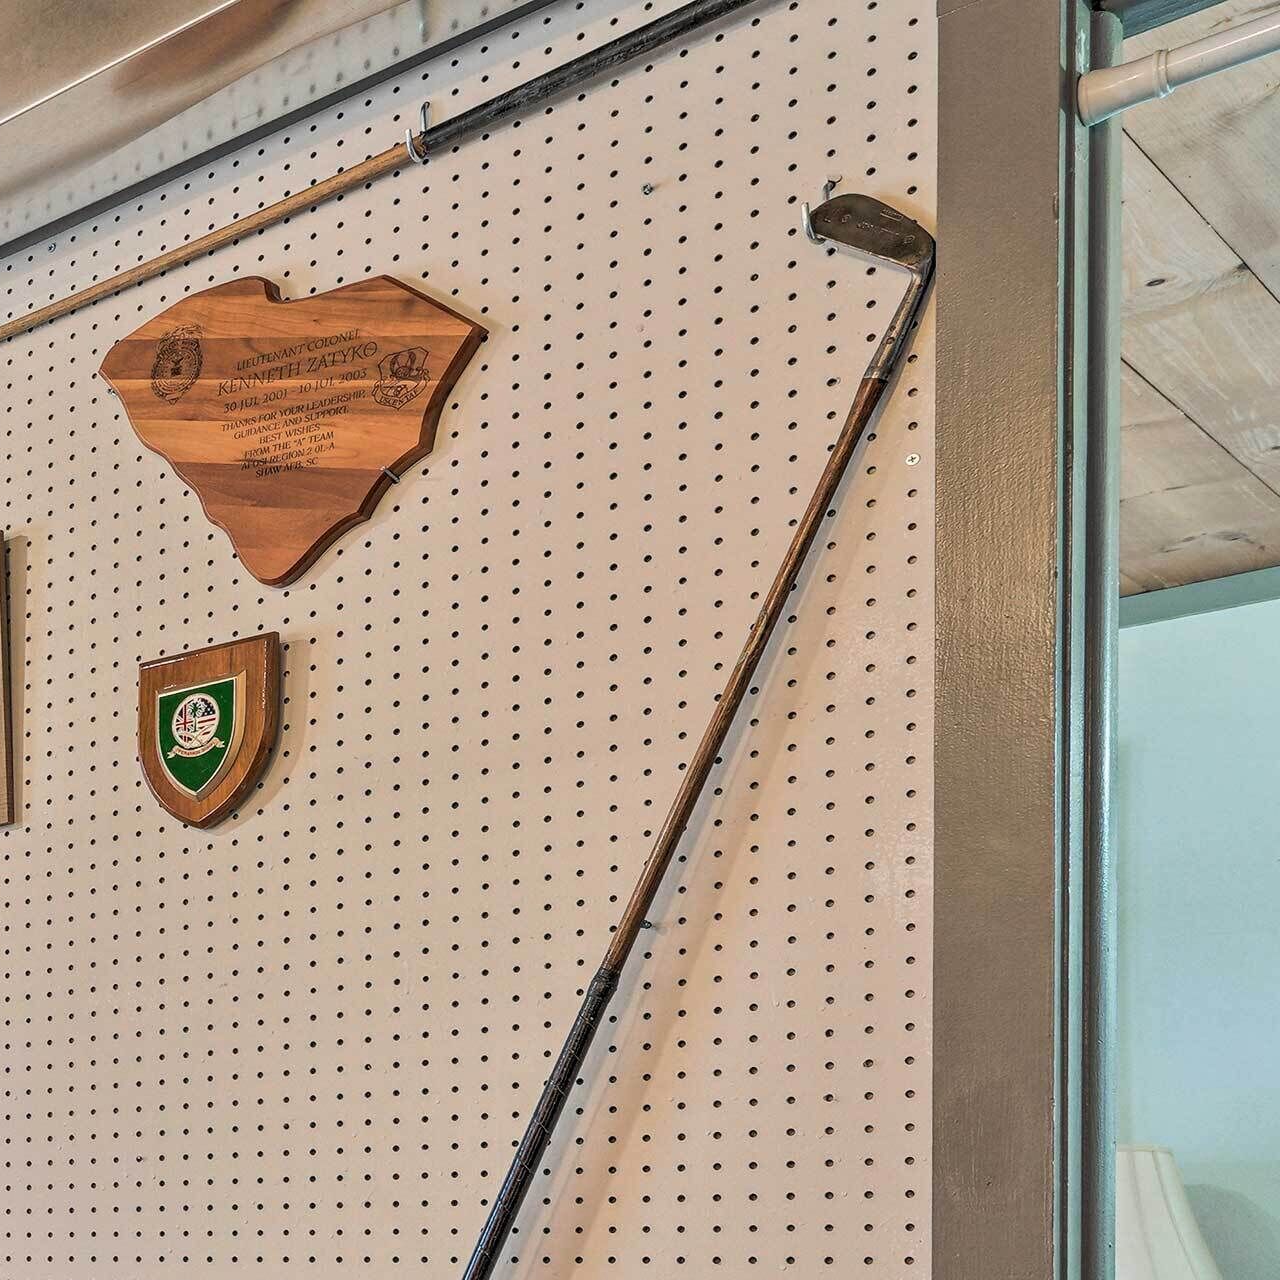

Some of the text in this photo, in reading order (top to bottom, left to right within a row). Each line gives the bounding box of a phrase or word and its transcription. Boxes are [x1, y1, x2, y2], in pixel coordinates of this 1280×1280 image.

[236, 328, 361, 371] LIEUTENANT COLONEL
[217, 341, 378, 396] KENNETH ZATYKO
[262, 390, 288, 404] 2001
[299, 382, 312, 394] 10
[338, 368, 368, 385] 2003
[221, 417, 257, 432] THANKS
[258, 412, 277, 424] FOR
[278, 404, 305, 417] YOUR
[233, 421, 281, 440] GUIDANCE
[282, 415, 303, 428] AND
[244, 446, 271, 460] FROM
[272, 441, 292, 453] THE
[308, 431, 335, 444] TEAM
[259, 423, 321, 445] BEST WISHES
[256, 465, 282, 478] SHAW
[306, 456, 319, 467] SC
[269, 448, 305, 464] REGION
